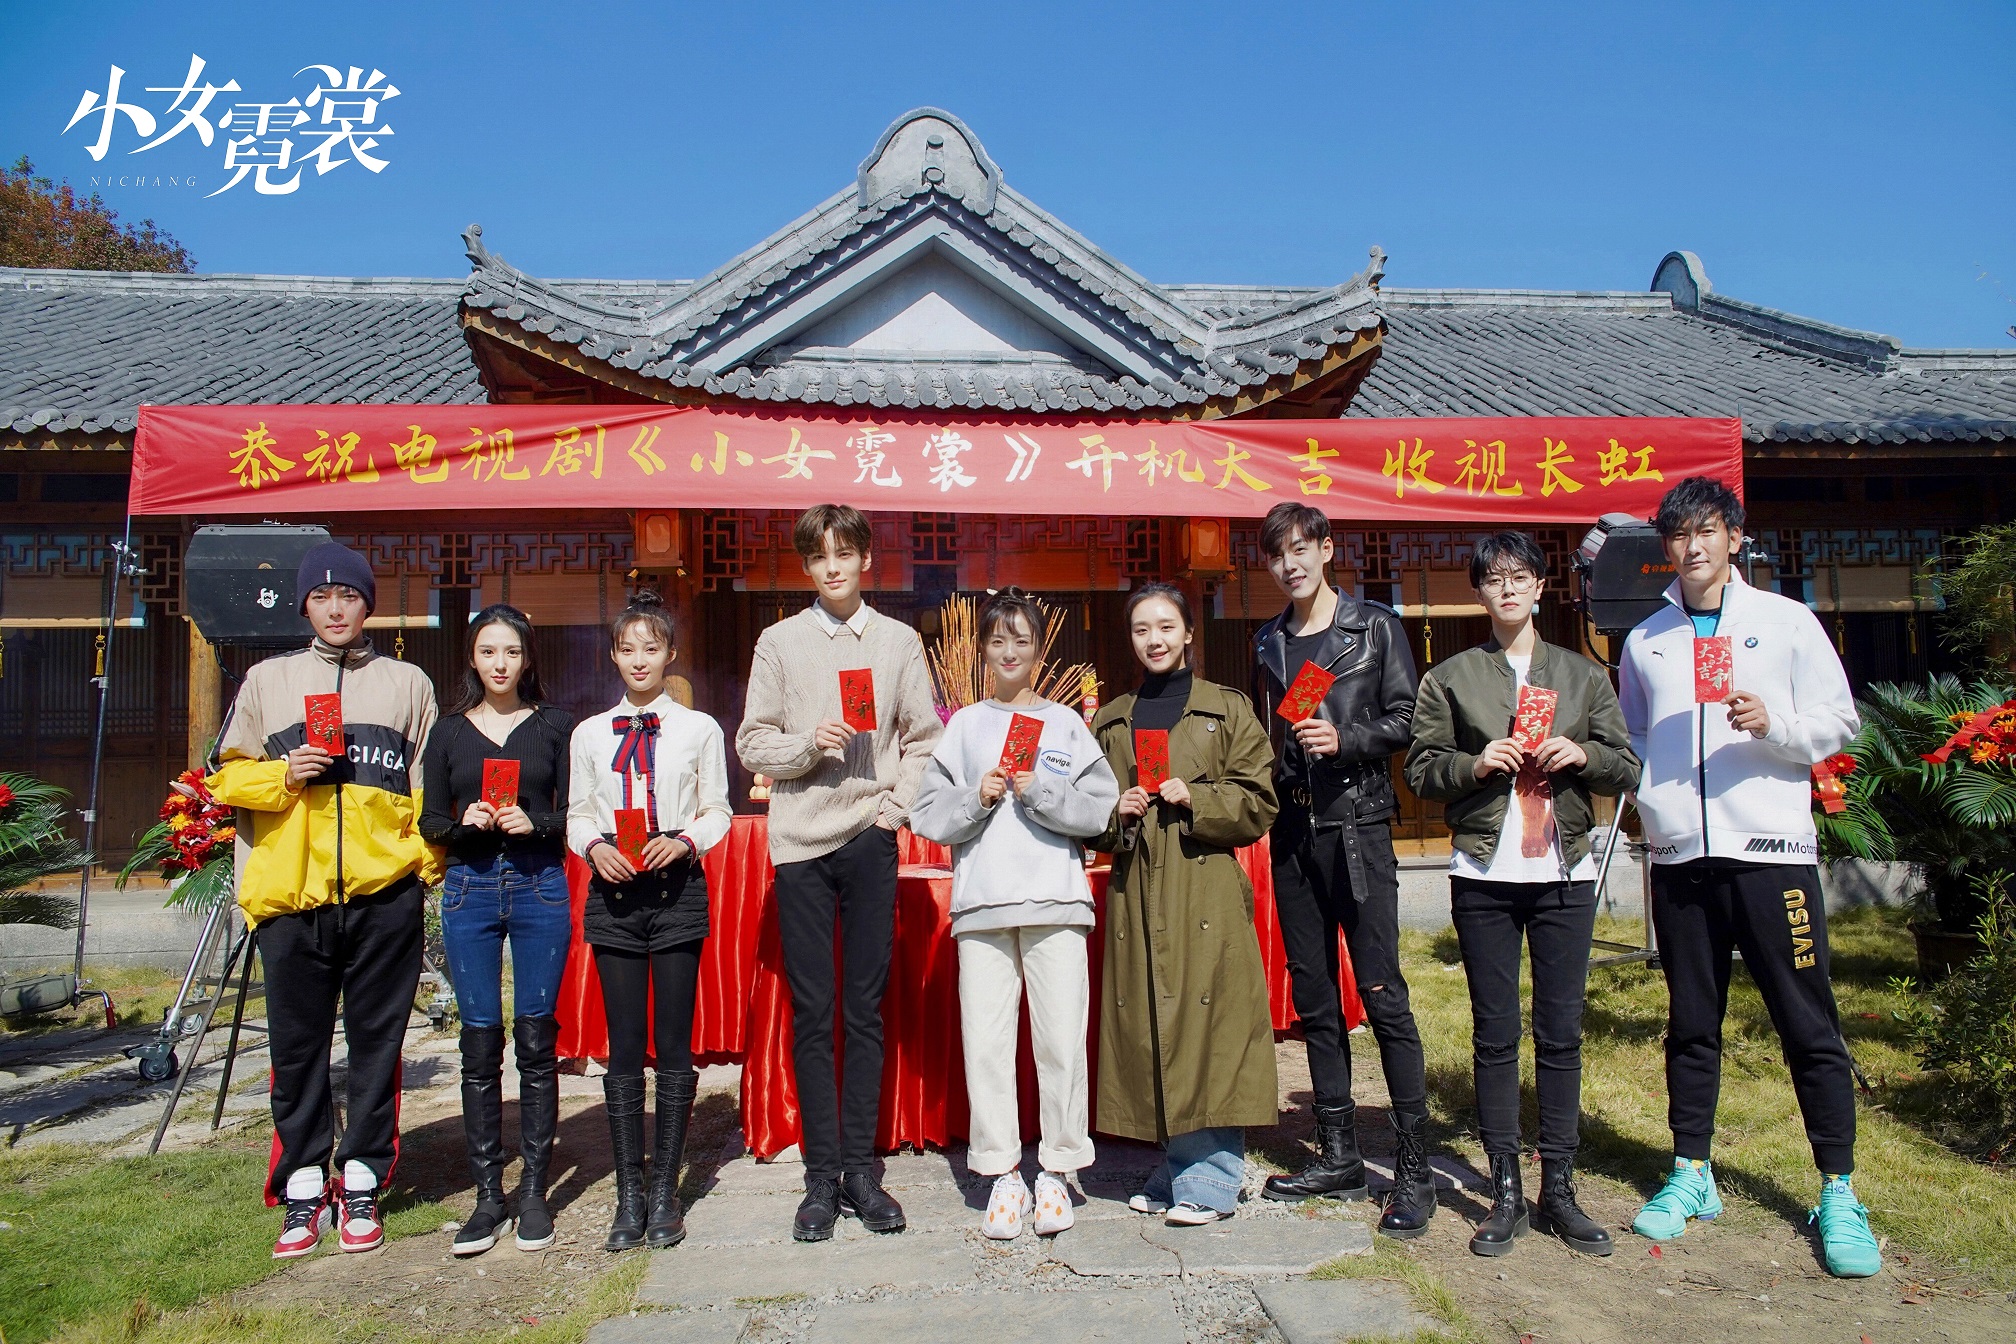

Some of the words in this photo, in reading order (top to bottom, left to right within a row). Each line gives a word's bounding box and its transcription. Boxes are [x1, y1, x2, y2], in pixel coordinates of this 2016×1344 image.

[1381, 436, 1666, 499] 收视长虹
[1696, 642, 1716, 680] 大吉
[1783, 889, 1816, 969] EVISU
